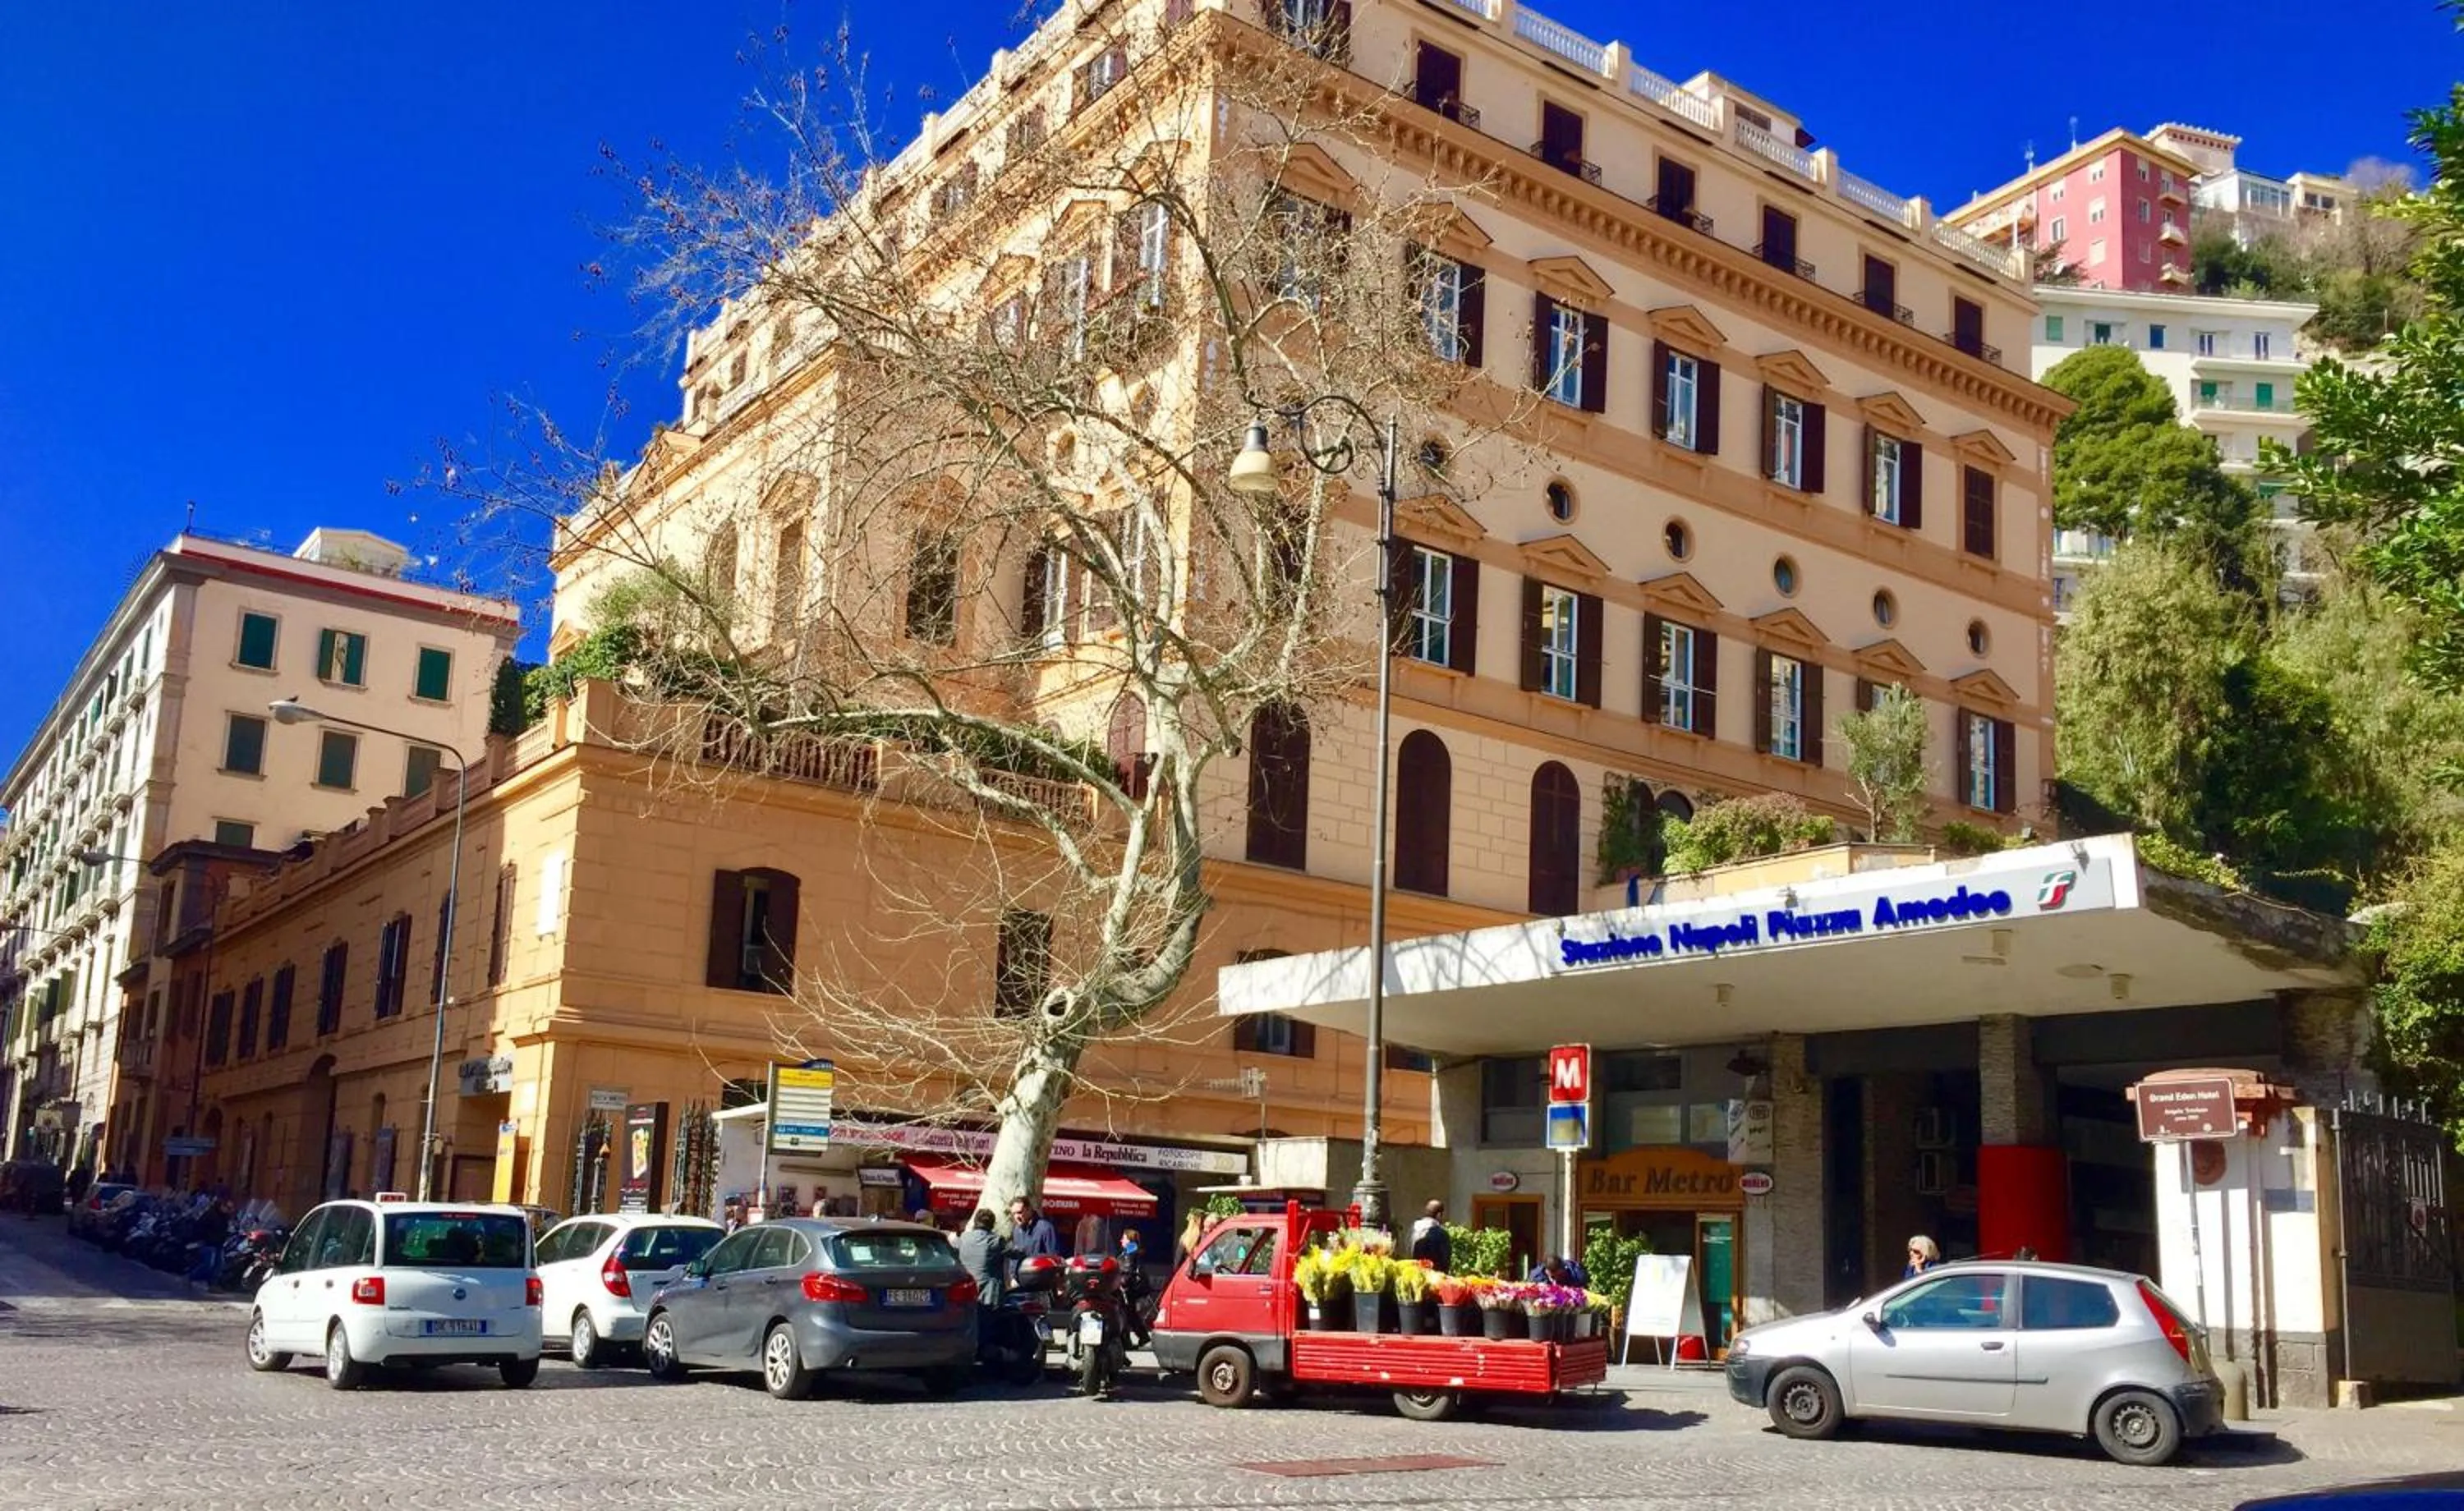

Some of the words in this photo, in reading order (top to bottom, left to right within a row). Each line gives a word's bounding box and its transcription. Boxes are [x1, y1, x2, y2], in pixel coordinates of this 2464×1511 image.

[1561, 933, 1662, 965] Stazione
[1668, 913, 1760, 953] Napoli
[1767, 908, 1863, 940] Piazza
[1873, 885, 2012, 926] Amedeo
[1555, 1057, 1581, 1089] M
[2149, 1093, 2174, 1103] Grand
[1082, 1142, 1092, 1157] la
[1093, 1144, 1147, 1163] Repubblica
[1587, 1168, 1637, 1195] Bar
